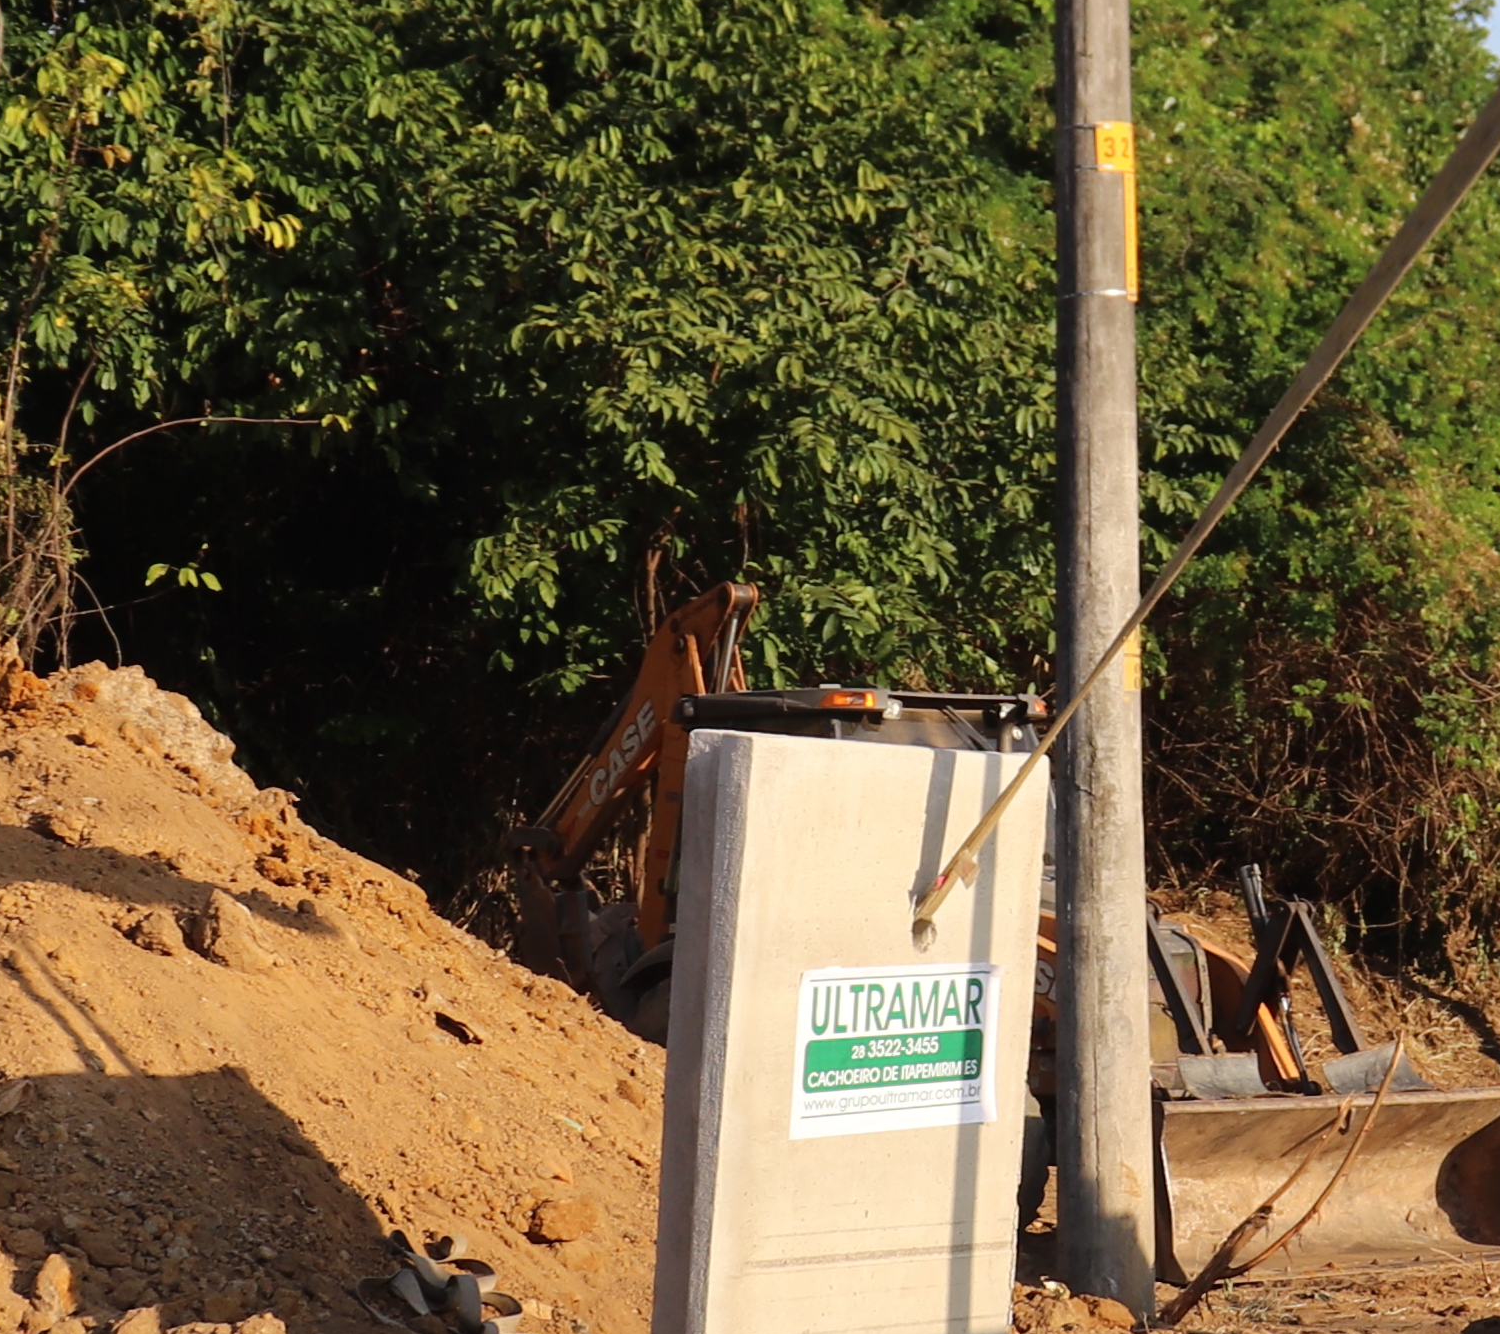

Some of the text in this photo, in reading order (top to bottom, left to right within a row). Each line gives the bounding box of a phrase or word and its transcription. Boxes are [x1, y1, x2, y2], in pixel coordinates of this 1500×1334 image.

[1102, 136, 1130, 159] 32
[589, 698, 657, 806] CASE
[811, 977, 984, 1036] ULTRAMAR
[867, 1036, 939, 1058] 3522-3455
[807, 1059, 978, 1088] CACHOEIRO DE ITAPEMIRIM ES
[803, 1083, 981, 1112] www.grupoultramar.com.br
